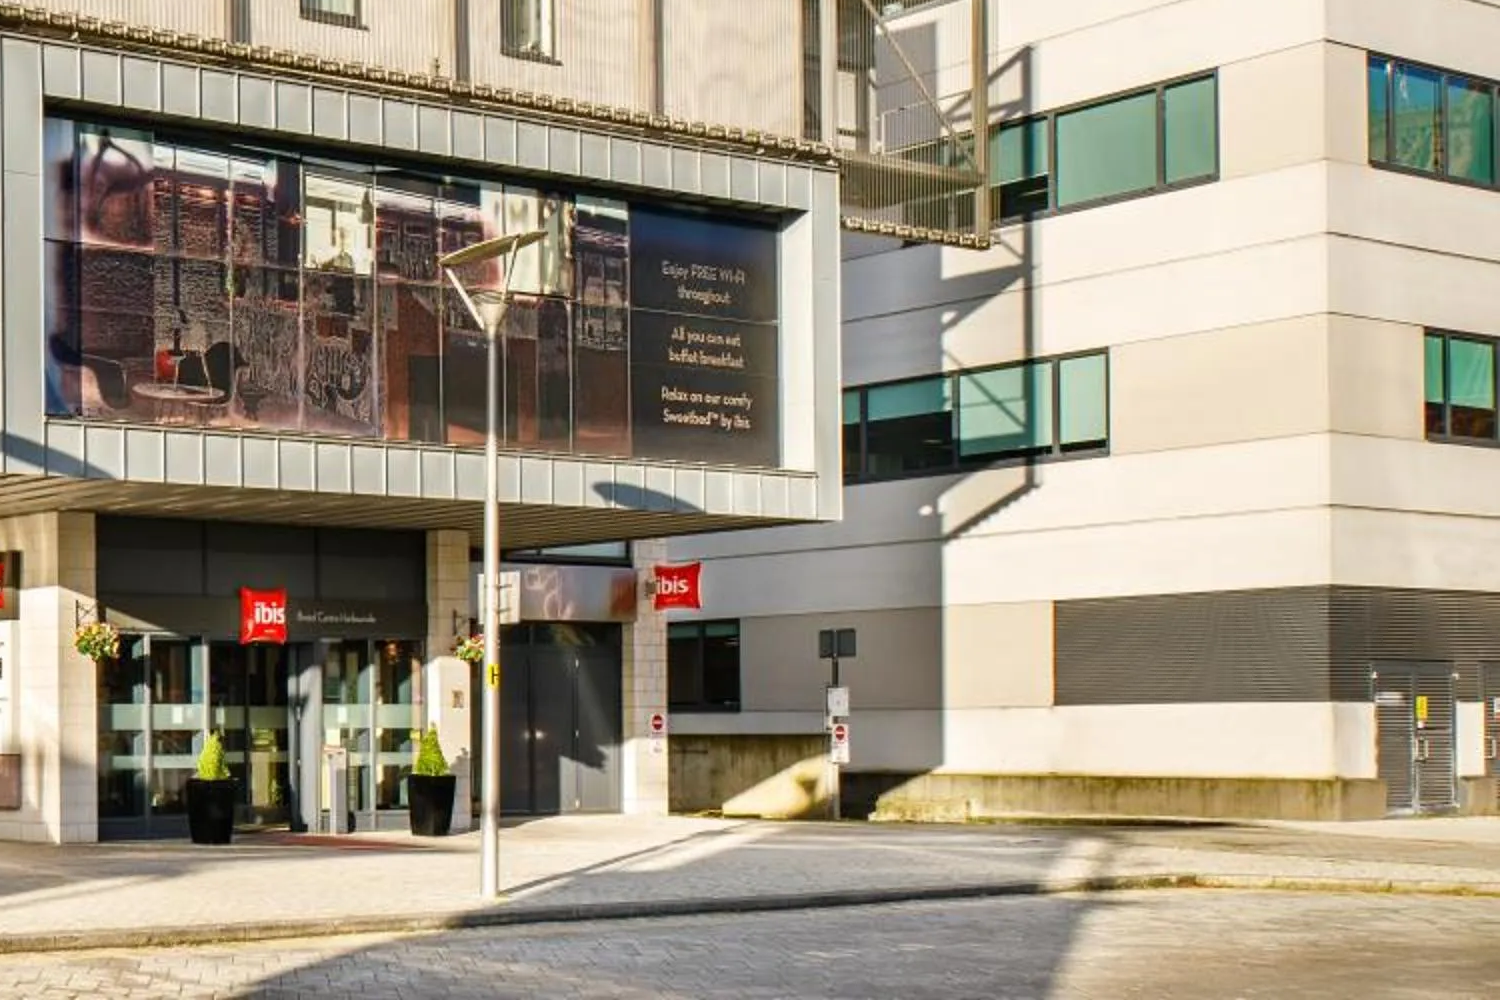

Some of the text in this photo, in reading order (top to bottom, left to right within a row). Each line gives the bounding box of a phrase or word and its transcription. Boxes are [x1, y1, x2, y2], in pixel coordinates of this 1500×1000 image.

[660, 260, 689, 280] Enjoy
[690, 263, 717, 281] FREE
[671, 325, 742, 347] All you can eat
[661, 385, 754, 411] Relax on our comfy
[720, 413, 733, 431] by
[657, 575, 689, 595] ibis
[254, 600, 286, 625] ibis
